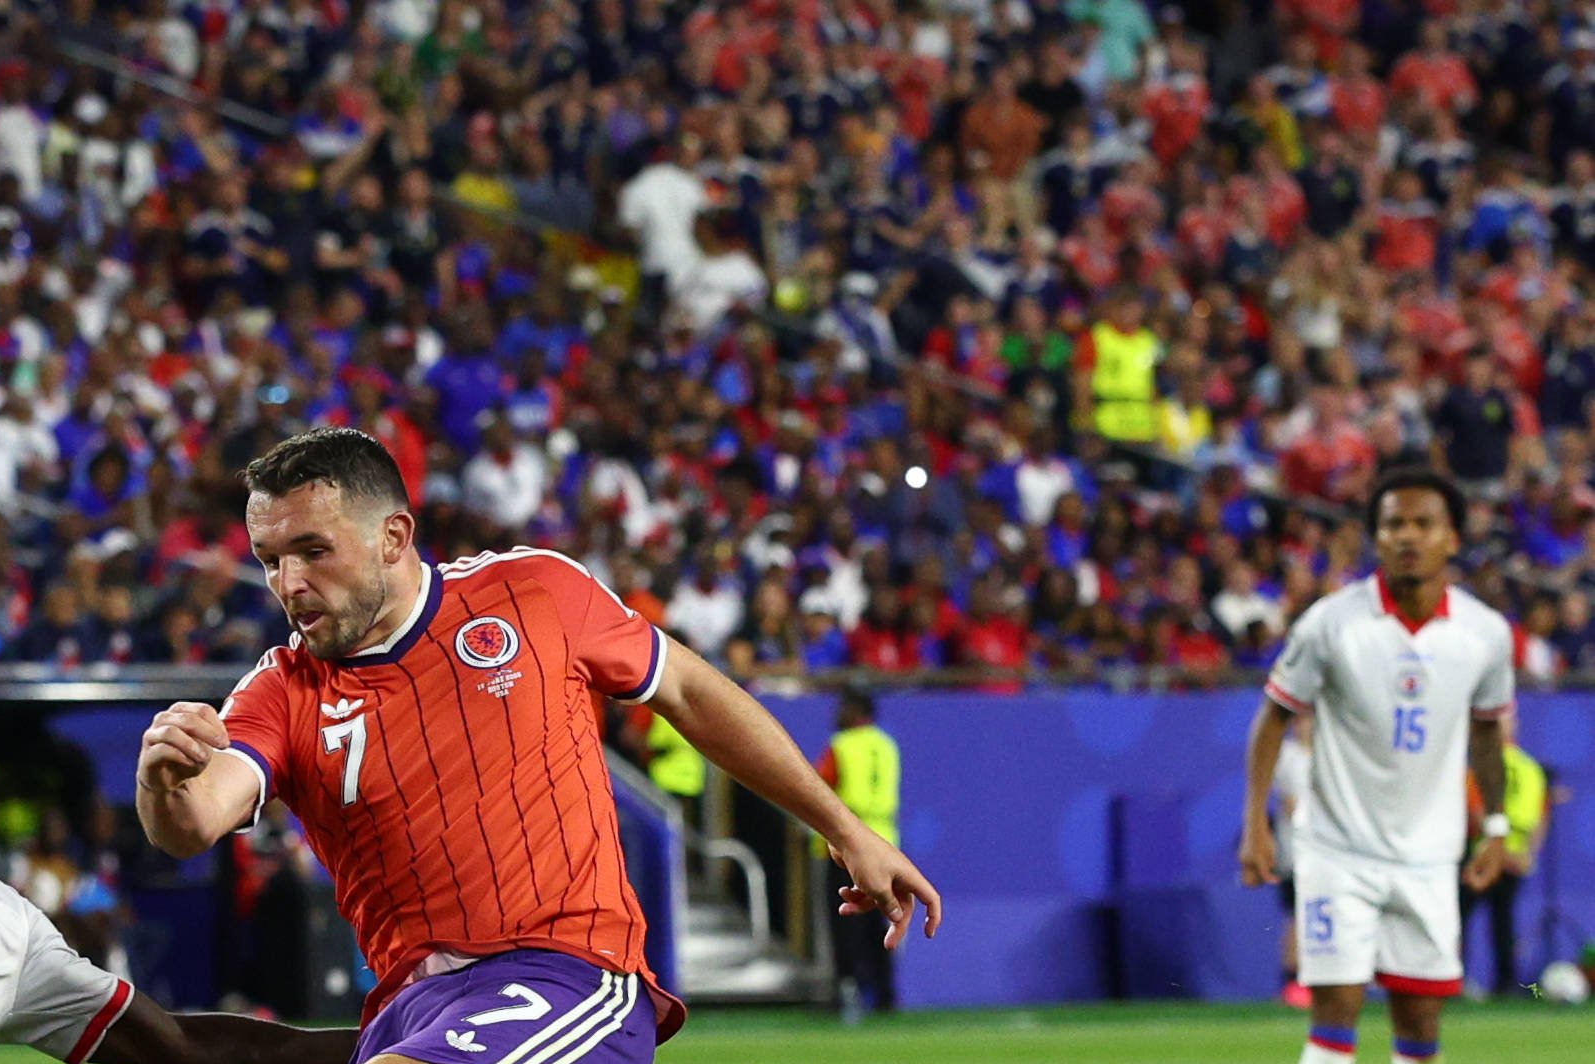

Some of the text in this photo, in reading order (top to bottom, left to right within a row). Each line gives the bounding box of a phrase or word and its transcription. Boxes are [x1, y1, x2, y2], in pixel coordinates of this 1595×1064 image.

[1393, 706, 1426, 754] 15
[321, 712, 367, 807] 7
[1305, 896, 1334, 942] 15
[461, 982, 553, 1026] 7
